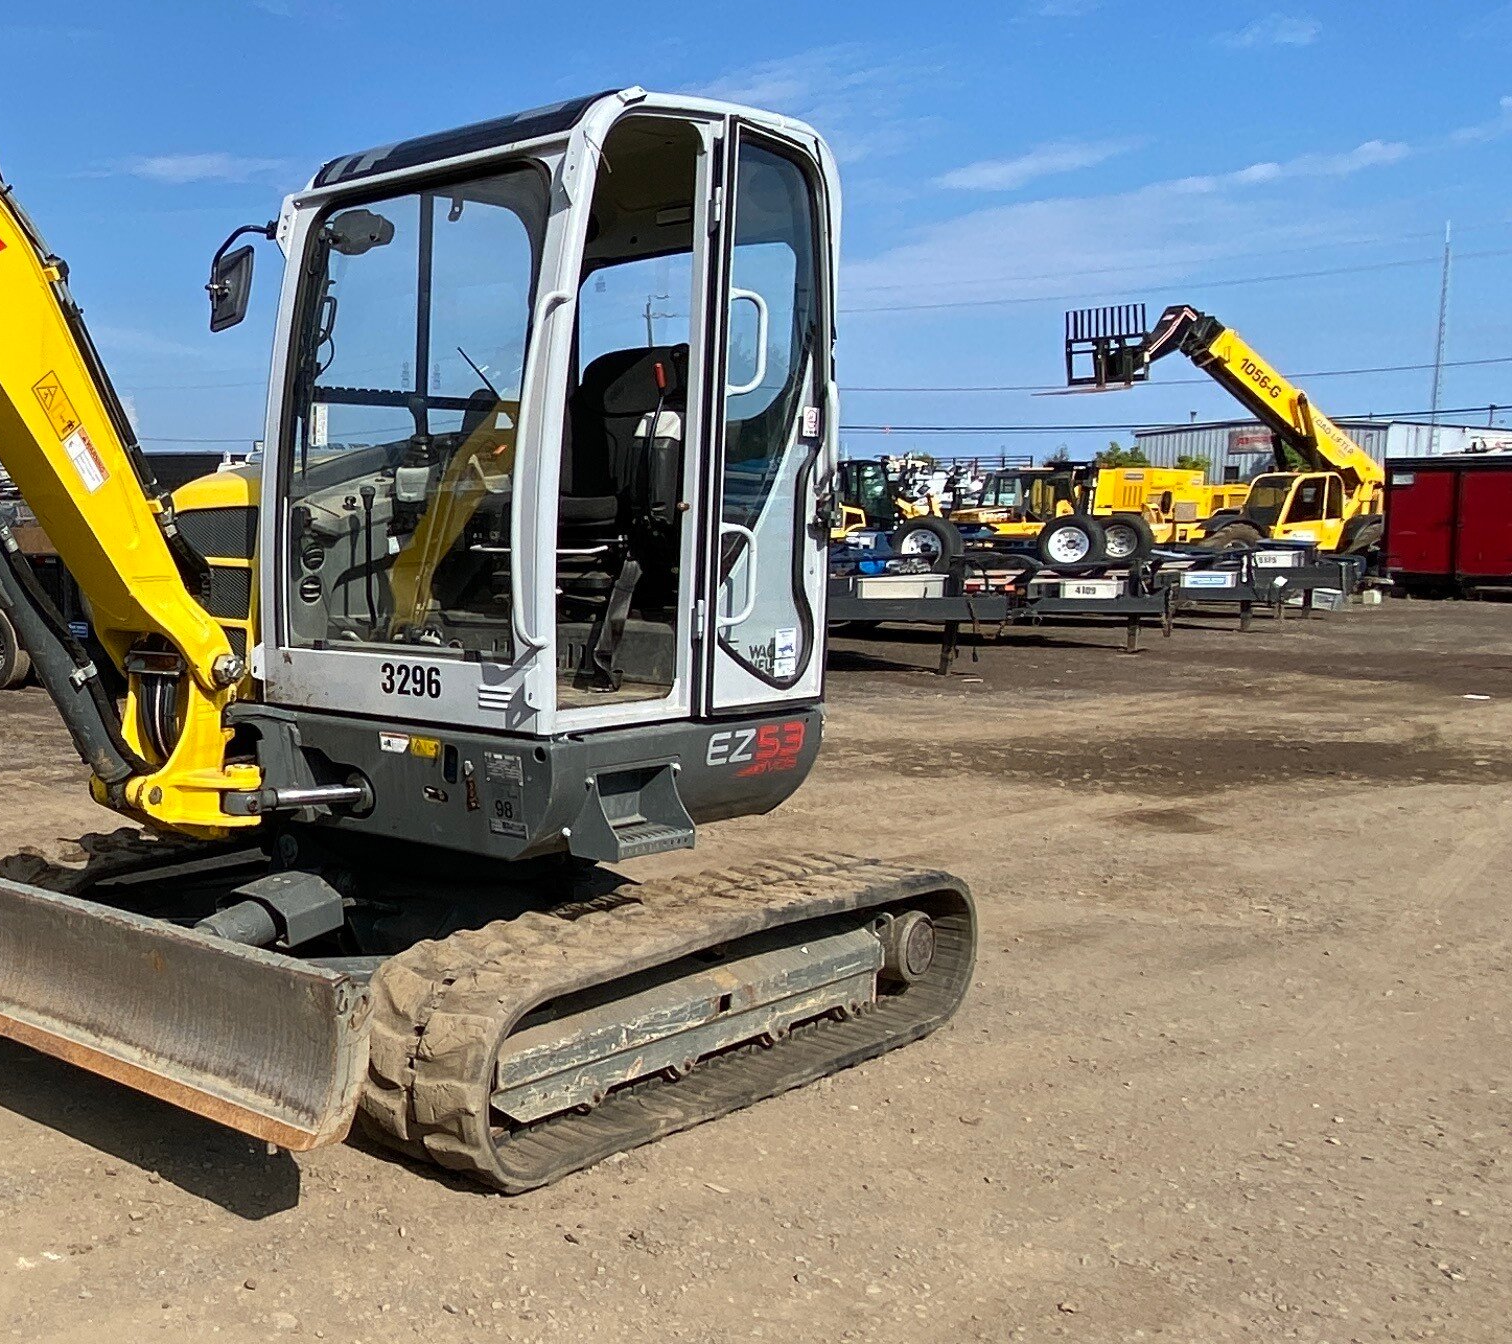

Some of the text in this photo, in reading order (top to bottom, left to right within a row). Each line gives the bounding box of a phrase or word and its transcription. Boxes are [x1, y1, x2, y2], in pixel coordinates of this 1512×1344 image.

[1240, 358, 1282, 399] 1056-G
[380, 662, 442, 699] 3296
[706, 721, 805, 766] EZ53
[495, 799, 513, 819] 98
